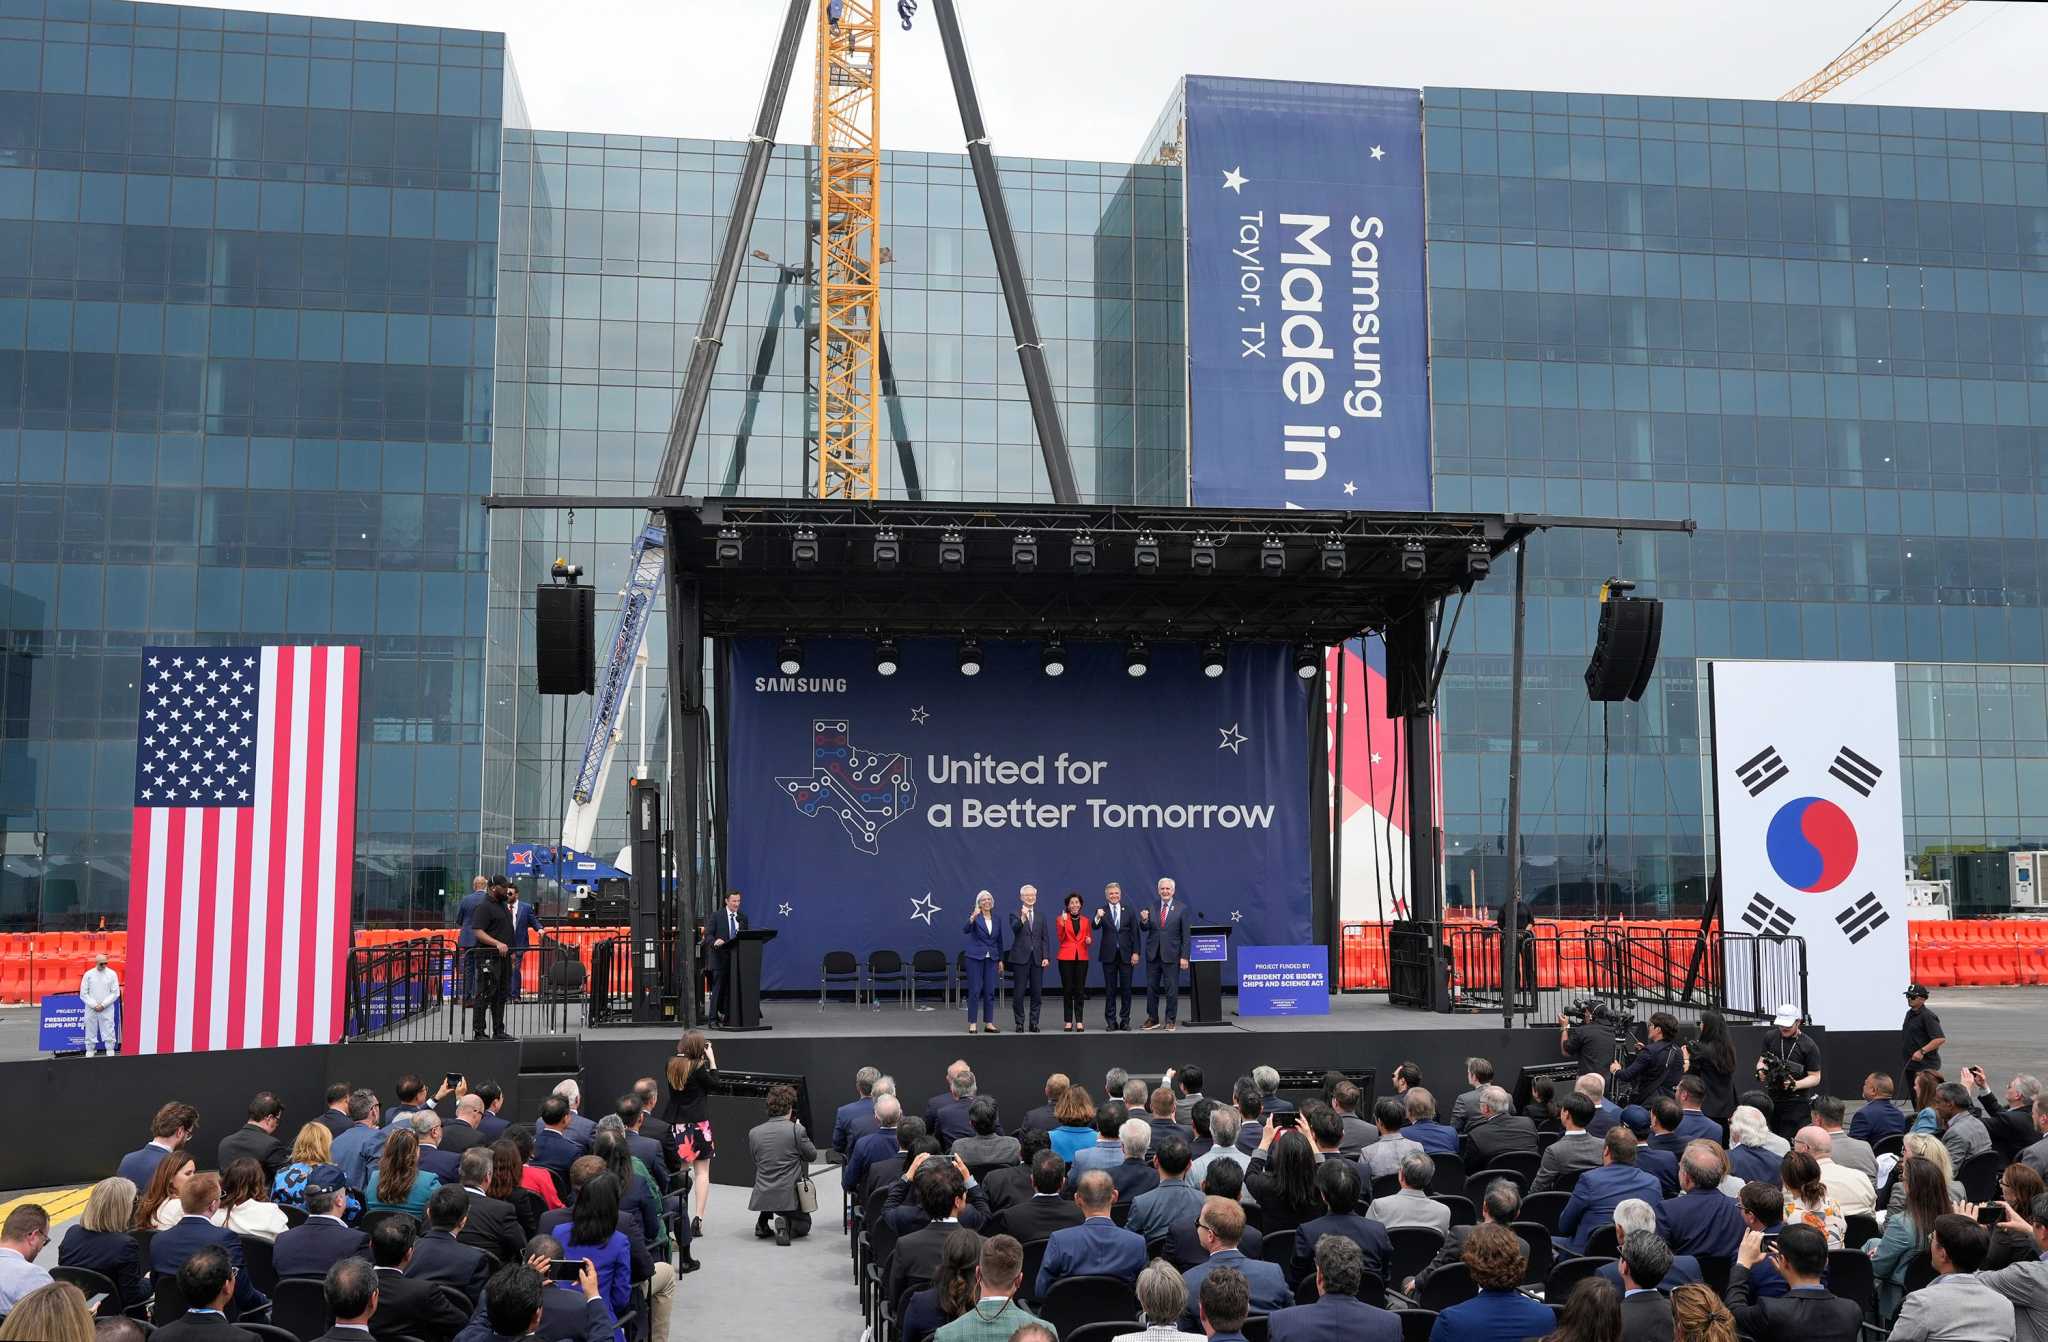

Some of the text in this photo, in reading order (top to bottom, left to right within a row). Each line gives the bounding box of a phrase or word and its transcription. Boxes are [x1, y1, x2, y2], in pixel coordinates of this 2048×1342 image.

[1232, 210, 1266, 359] Taylor, TX
[1343, 215, 1384, 418] Samsung
[1279, 213, 1341, 481] Made in
[755, 677, 847, 693] SAMSUNG
[927, 752, 1108, 785] United for
[927, 798, 1275, 829] a Better Tomorrow
